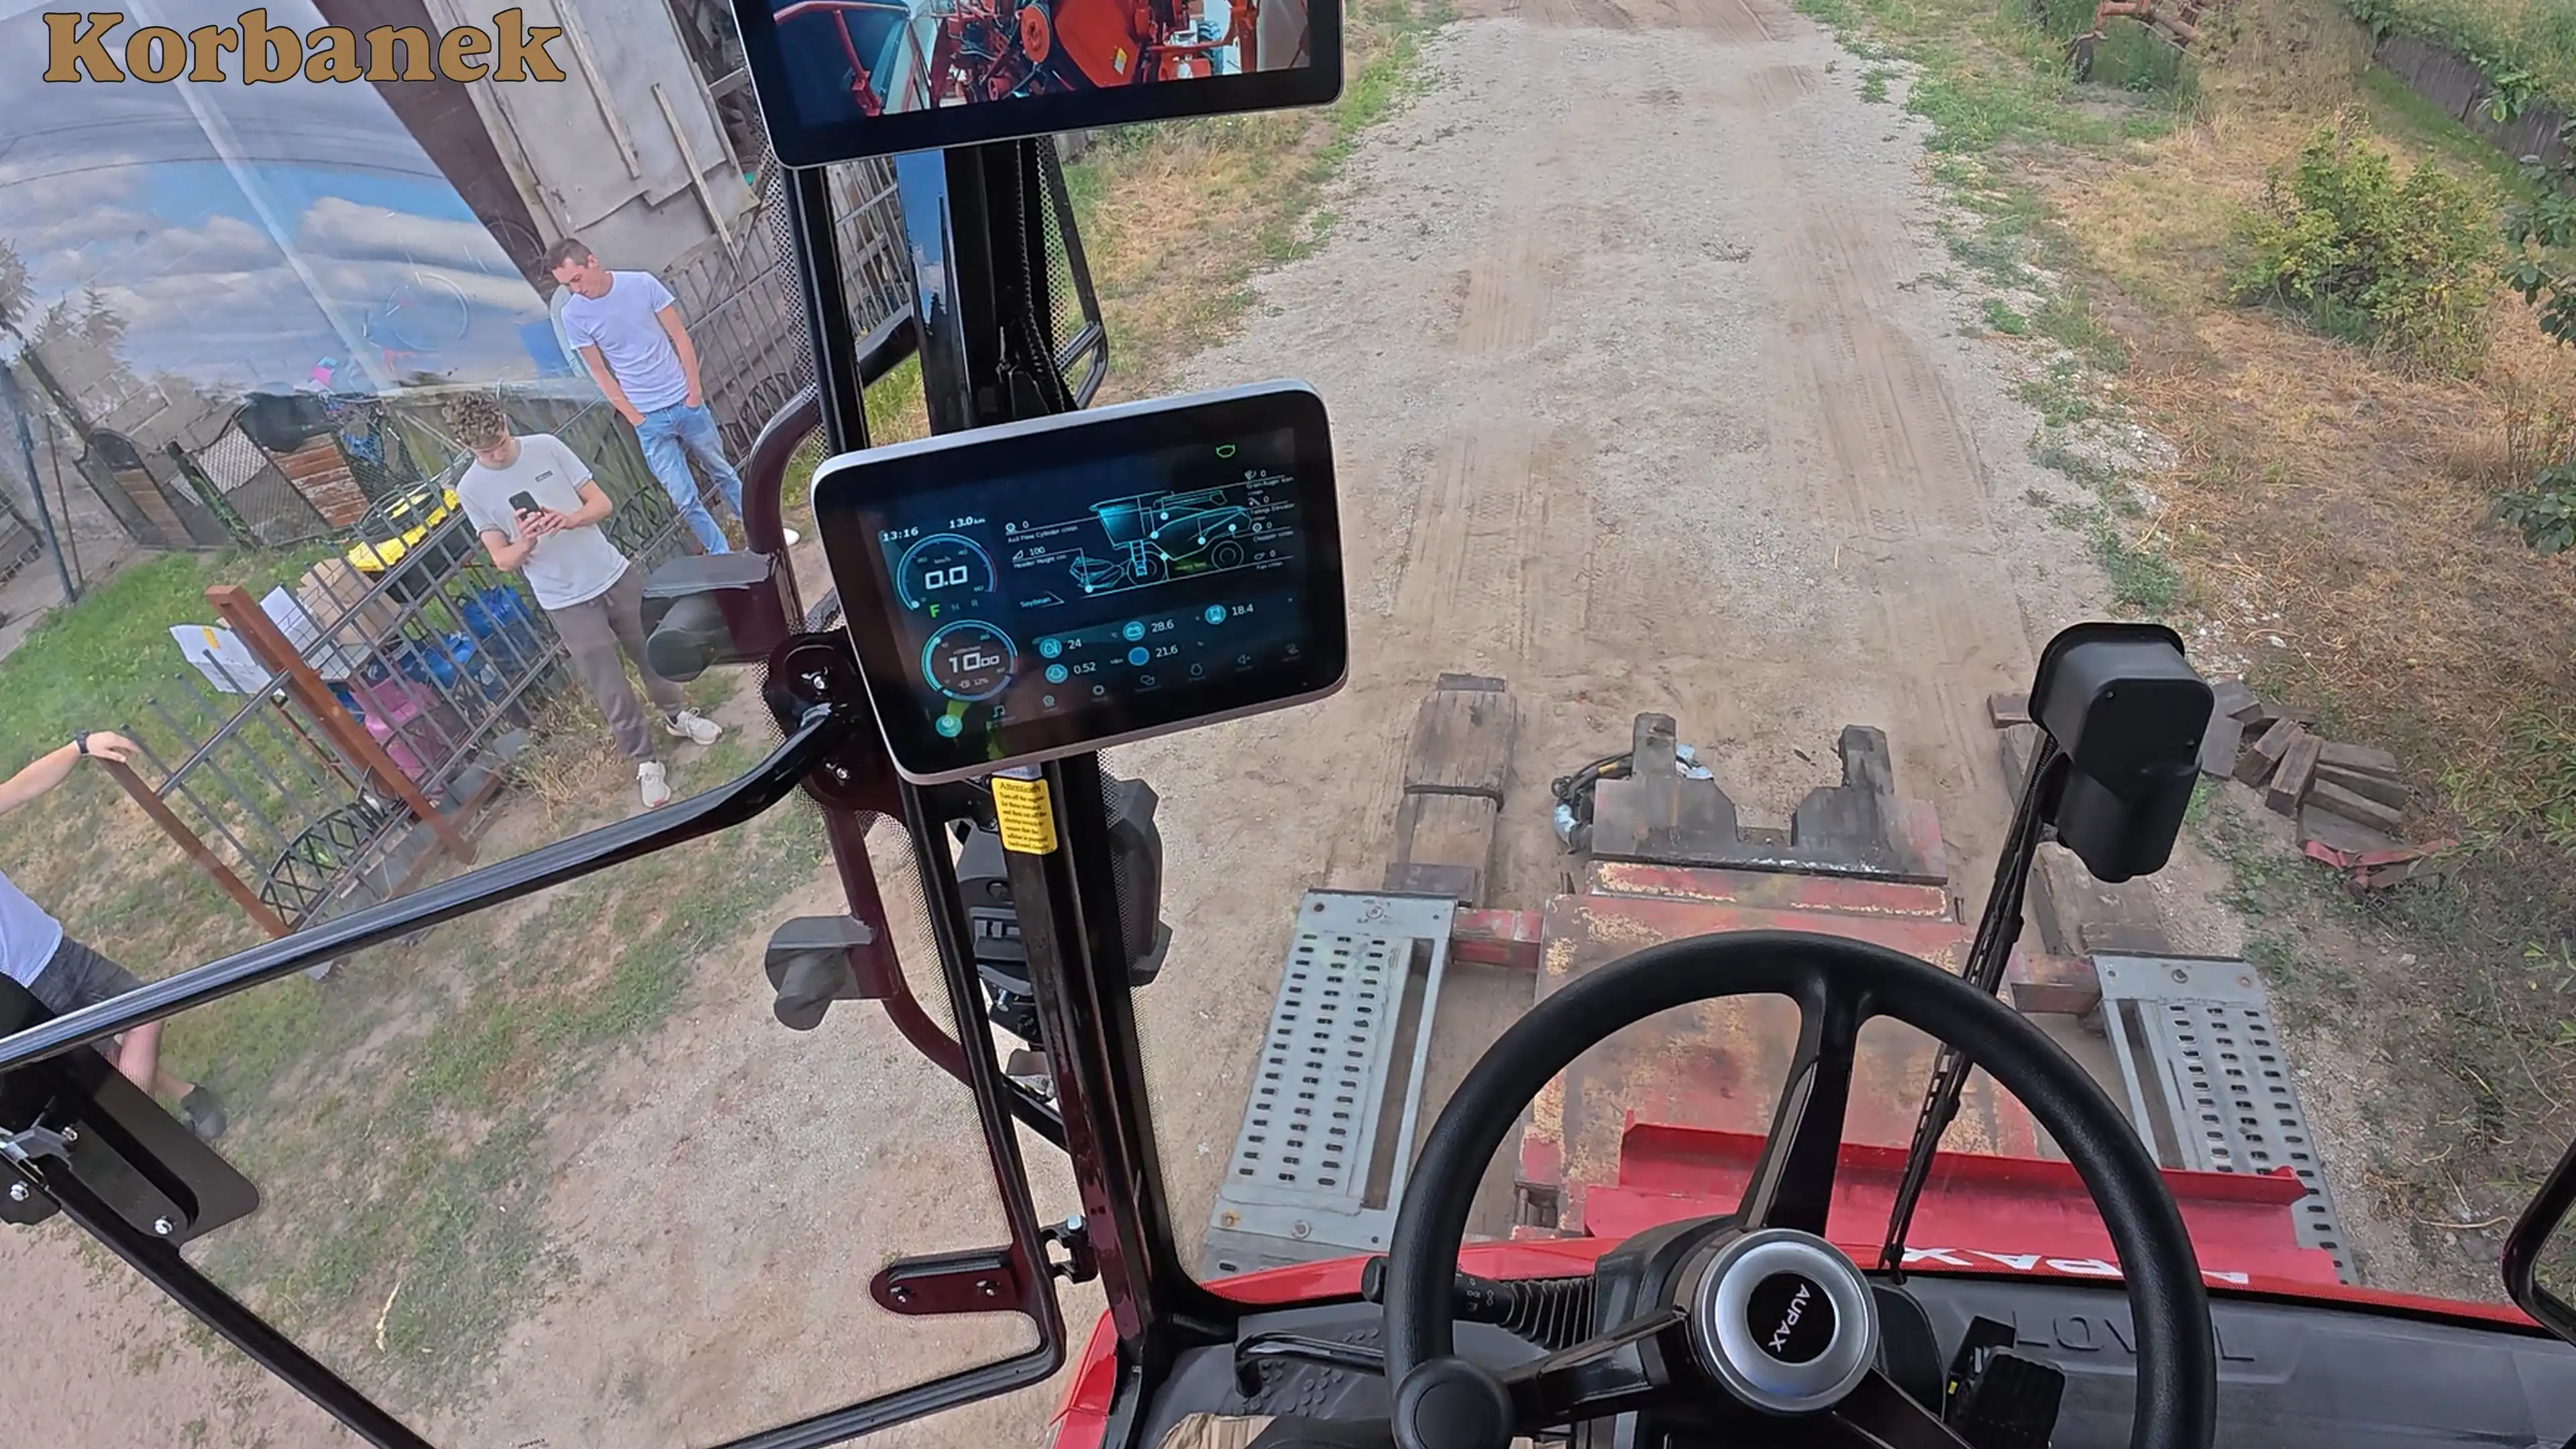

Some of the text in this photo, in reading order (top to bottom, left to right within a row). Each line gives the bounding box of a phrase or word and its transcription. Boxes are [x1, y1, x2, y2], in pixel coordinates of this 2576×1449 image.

[949, 517, 973, 529] 13.0
[882, 527, 919, 542] 13:16
[1029, 546, 1046, 556] 100
[925, 566, 968, 590] 0.0
[929, 604, 940, 618] F
[1232, 604, 1254, 616] 18.4
[1150, 619, 1175, 633] 28.6
[1067, 639, 1083, 650] 24
[1155, 645, 1179, 658] 21.6
[949, 652, 1000, 673] 1000
[1073, 661, 1097, 675] 0.52
[1768, 1283, 1812, 1354] AUPAX
